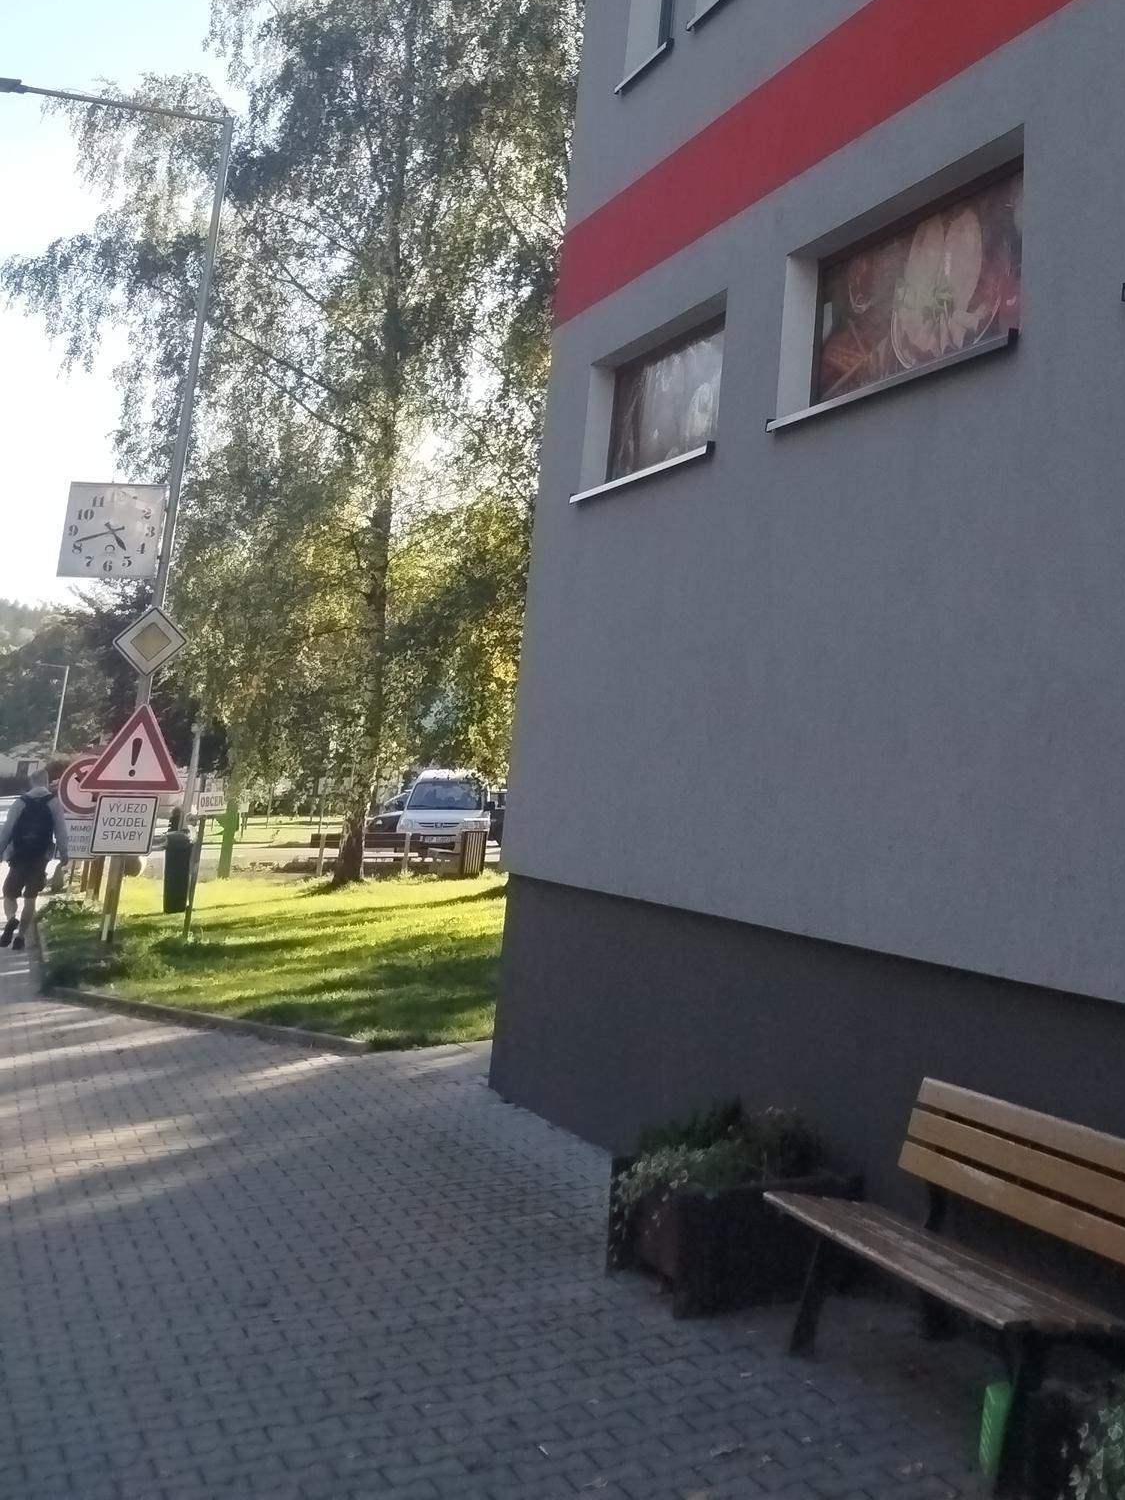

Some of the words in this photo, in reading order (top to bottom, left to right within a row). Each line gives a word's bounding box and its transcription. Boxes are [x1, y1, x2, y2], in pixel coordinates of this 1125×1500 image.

[92, 496, 105, 507] 11
[78, 509, 94, 520] 10
[142, 508, 152, 519] 2
[68, 525, 78, 536] 9
[146, 526, 155, 537] 3
[72, 542, 82, 554] 8
[137, 543, 145, 554] 4
[85, 556, 94, 567] 7
[103, 560, 112, 572] 6
[122, 556, 132, 567] 5
[102, 817, 147, 828] VOZIDEL
[70, 825, 91, 833] MIMO
[102, 831, 144, 841] STAVBY
